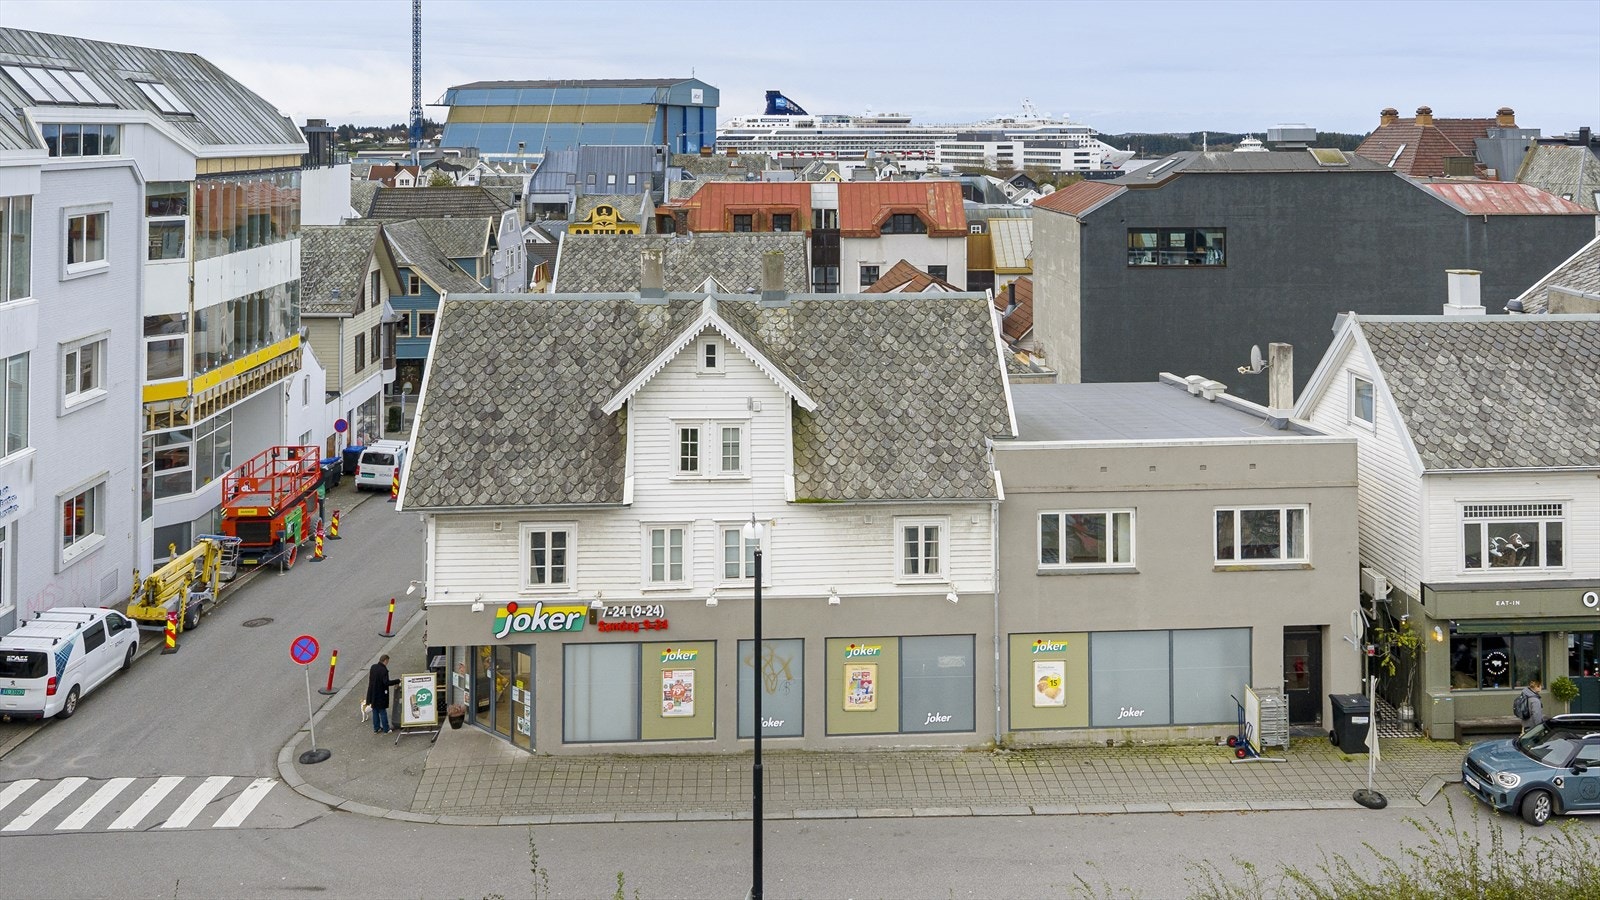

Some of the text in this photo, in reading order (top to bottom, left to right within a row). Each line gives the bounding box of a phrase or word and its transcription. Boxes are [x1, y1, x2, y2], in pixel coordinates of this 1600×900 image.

[630, 604, 665, 619] (9-24)
[495, 601, 580, 639] joker
[846, 643, 880, 659] joker
[1033, 639, 1065, 654] joker
[662, 648, 696, 663] joker
[924, 712, 952, 725] joker
[1117, 706, 1145, 720] joker
[761, 716, 785, 727] oker
